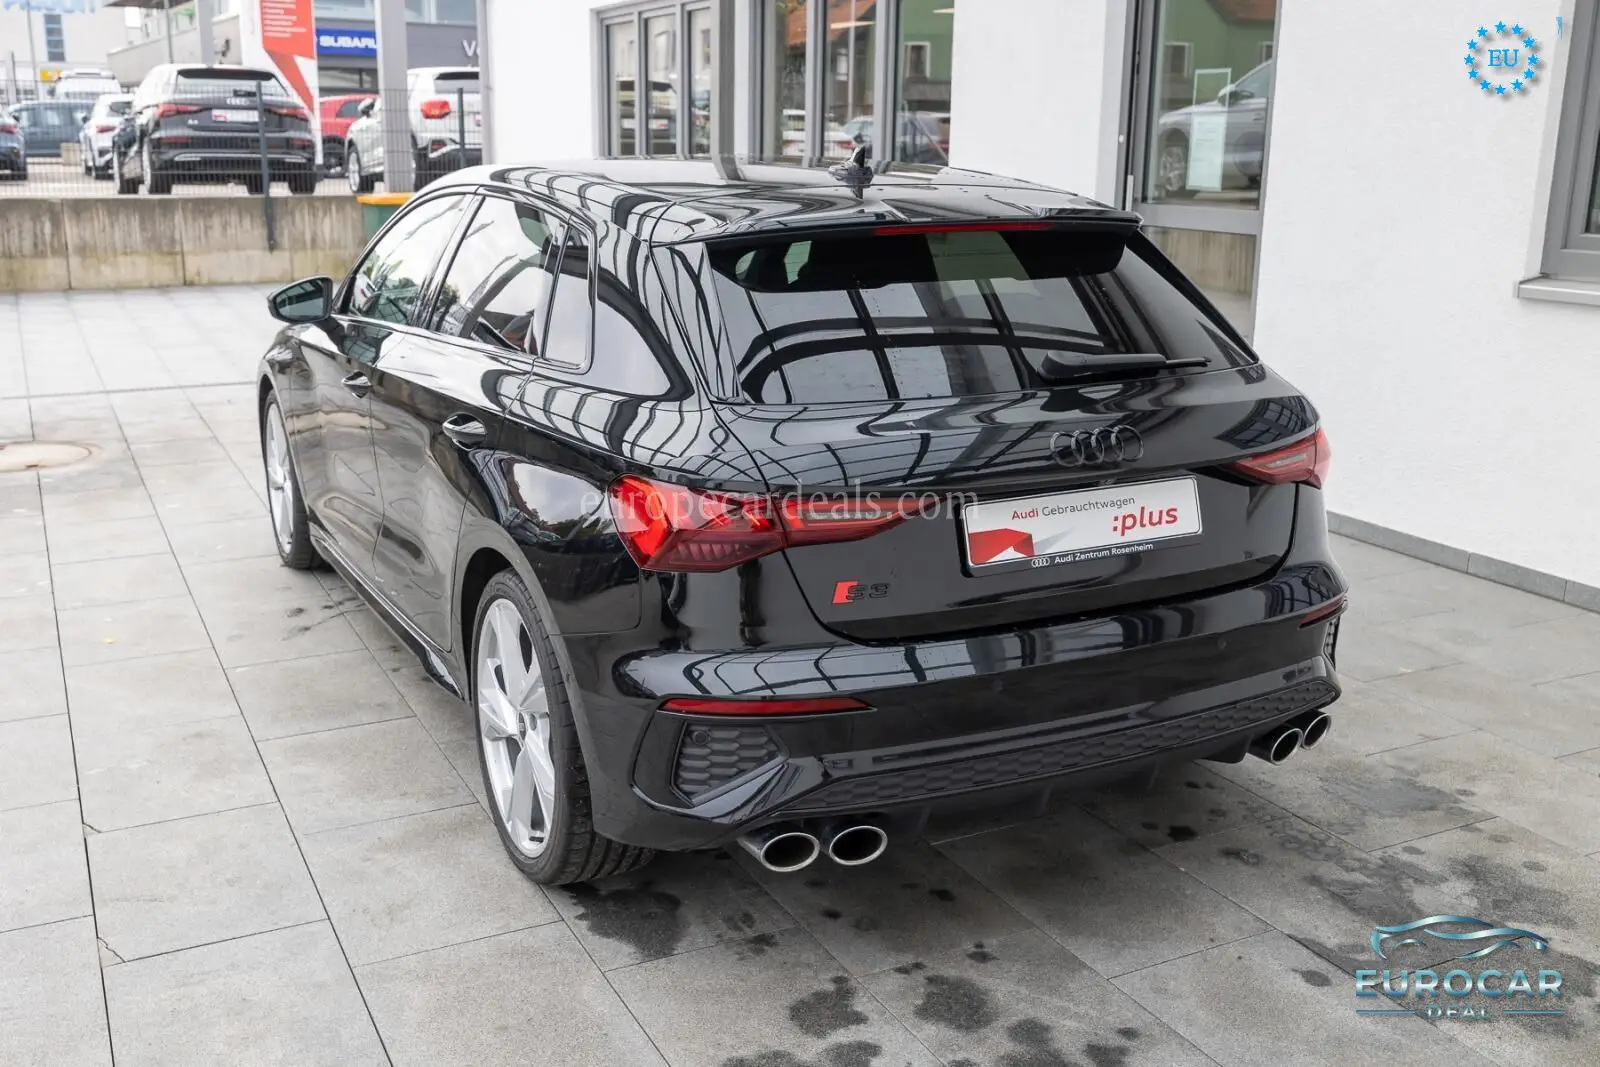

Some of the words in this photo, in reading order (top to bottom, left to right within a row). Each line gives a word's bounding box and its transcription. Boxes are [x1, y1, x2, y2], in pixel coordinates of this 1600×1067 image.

[1011, 508, 1039, 521] Audi
[1041, 496, 1135, 516] Gebrauchtwagen
[1054, 553, 1073, 564] Audi
[1075, 548, 1110, 561] Zentrum
[1111, 542, 1154, 556] Rosenheim
